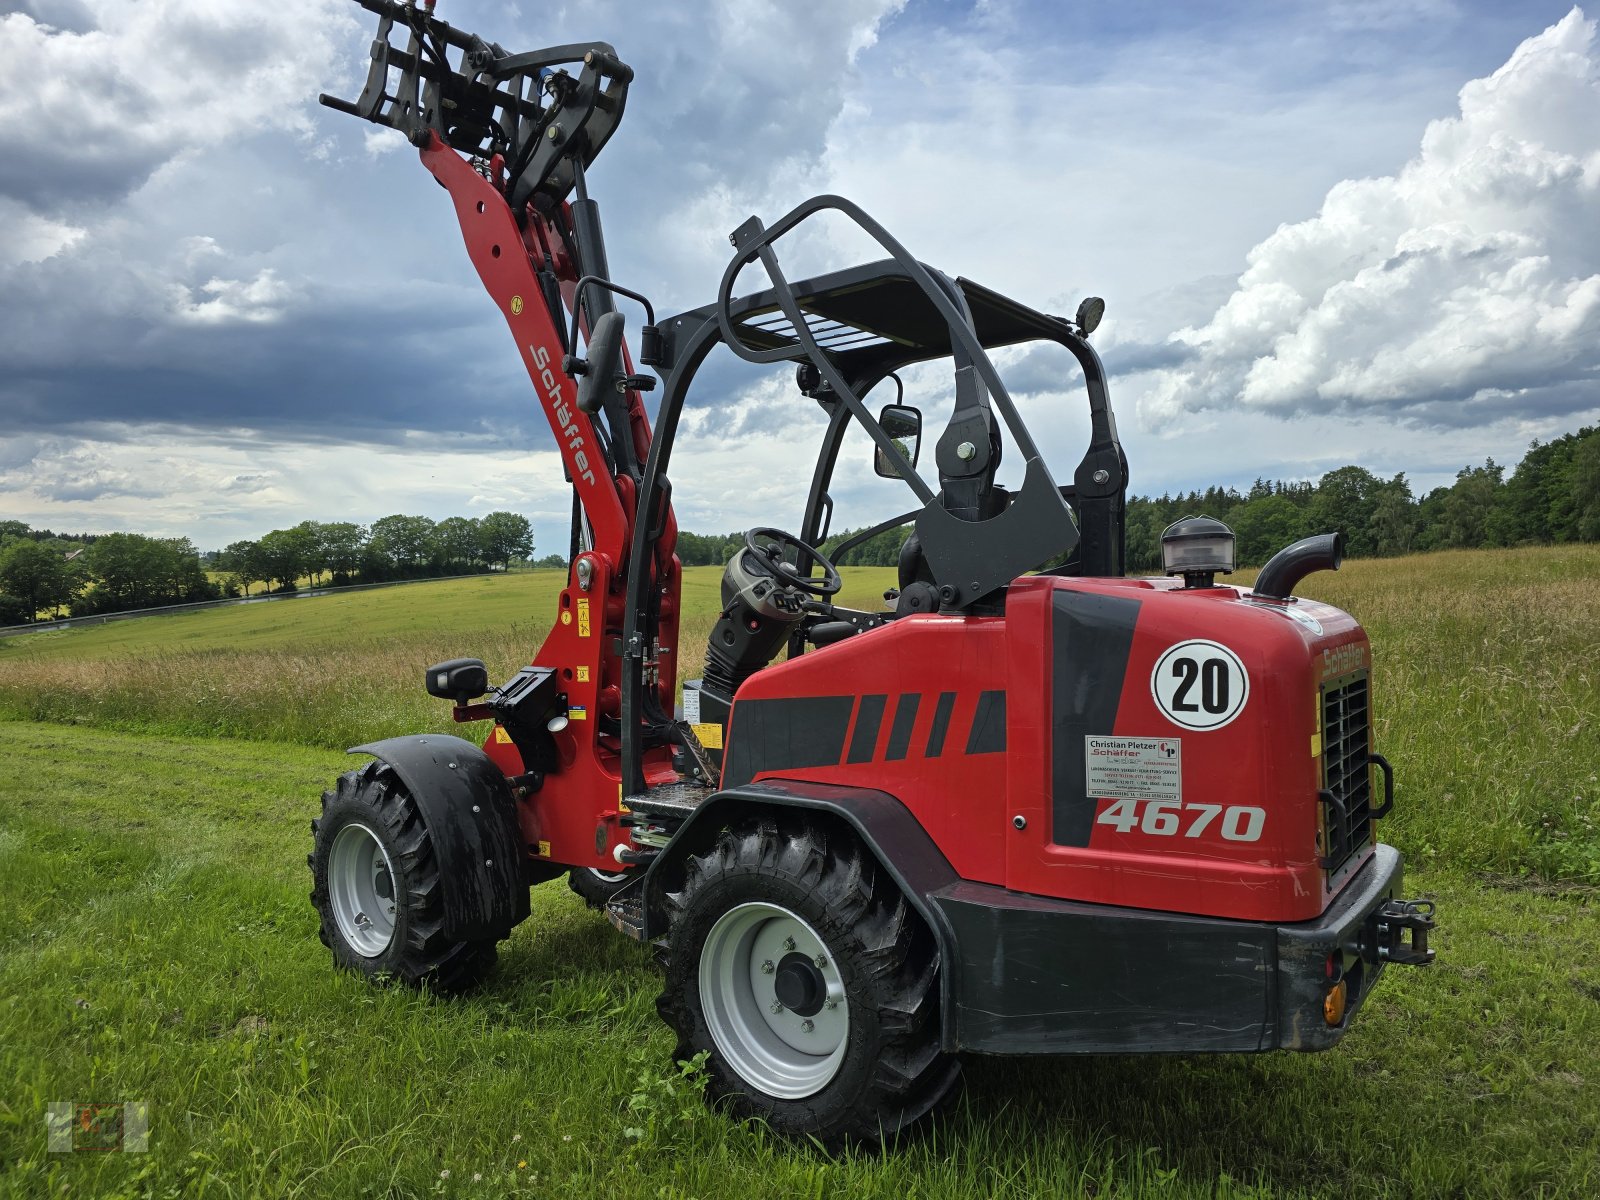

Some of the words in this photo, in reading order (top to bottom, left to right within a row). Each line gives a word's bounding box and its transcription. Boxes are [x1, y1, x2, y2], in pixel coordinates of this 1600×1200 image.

[529, 343, 595, 486] Schäffer
[1322, 643, 1365, 677] Schäffer
[1171, 657, 1230, 714] 20
[1090, 749, 1141, 757] Schäffer
[1091, 741, 1126, 749] Christian
[1097, 800, 1267, 843] 4670
